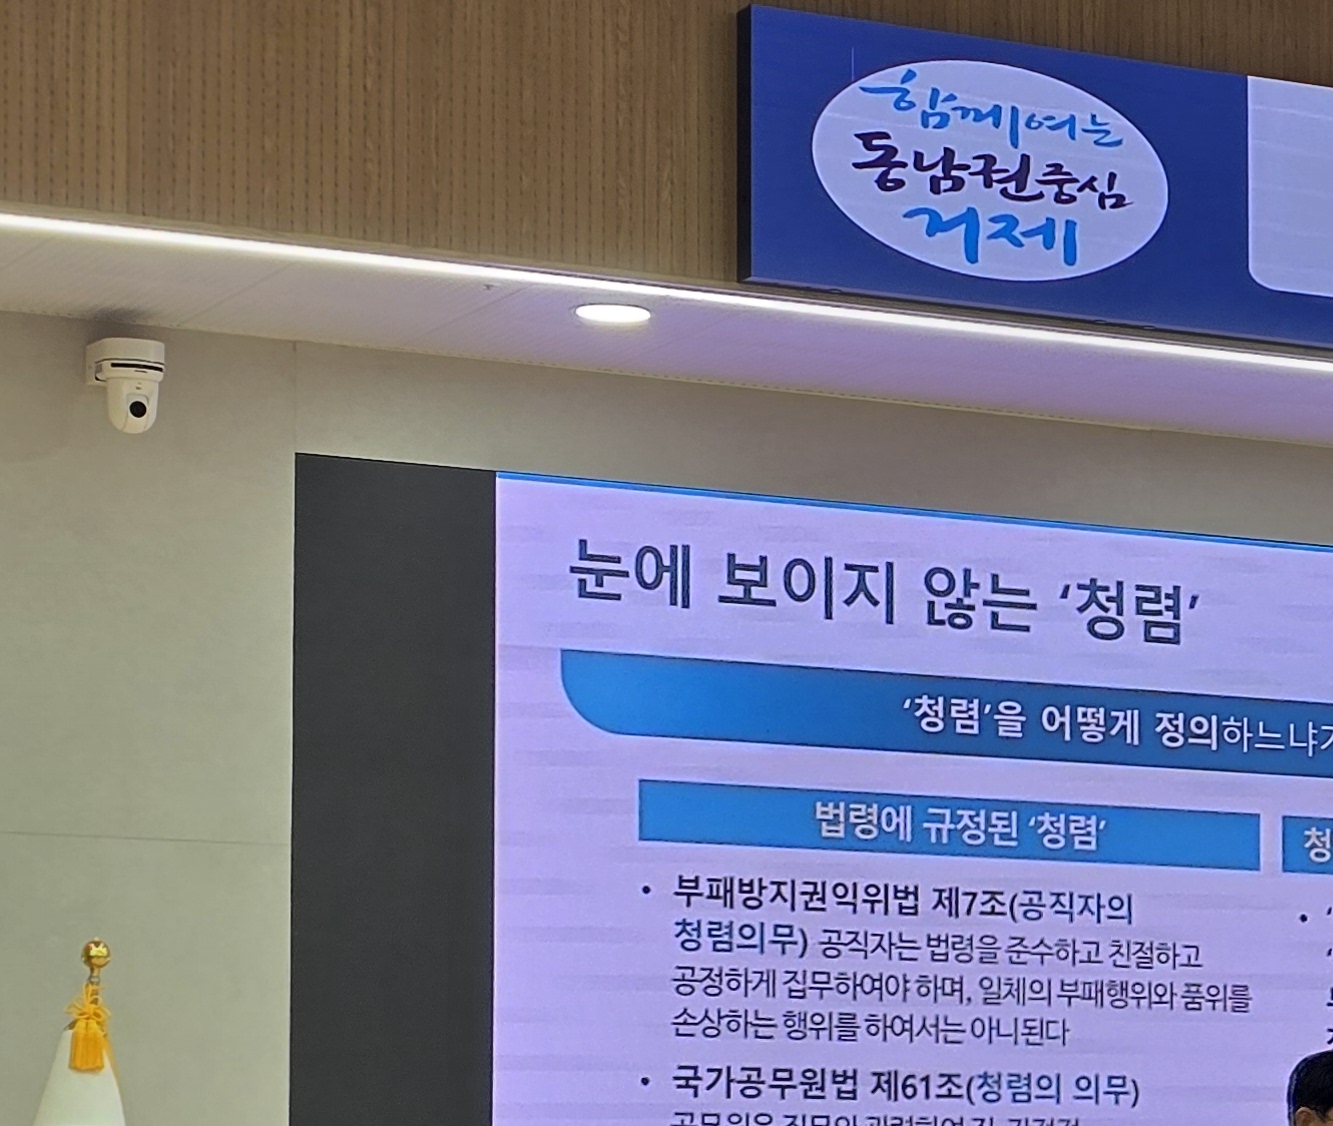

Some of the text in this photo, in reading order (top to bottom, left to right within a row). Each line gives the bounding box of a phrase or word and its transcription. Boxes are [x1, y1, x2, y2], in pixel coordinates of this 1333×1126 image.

[902, 206, 1078, 266] 거제
[569, 538, 1199, 646] 눈에 보이지 않는 ‘청렴’
[903, 695, 1026, 738] ‘청렴’을
[1041, 704, 1139, 745] 어떻게
[814, 802, 1105, 851] 법령에 규정된 ‘청렴’
[673, 874, 1133, 925] 부패방지권익위법 제7조(공직자의
[674, 918, 1204, 971] 청렴의무) 공직자는 법령을 준수하고 친절하고
[672, 965, 1252, 1013] 공정하게 집무하여야 하며, 일체의 부패행위와 품위를
[671, 1007, 1070, 1047] 손상하는 행위를 하여서는 아니된다
[672, 1065, 1140, 1108] 국가공무원법 제61조(청렴의 의무)
